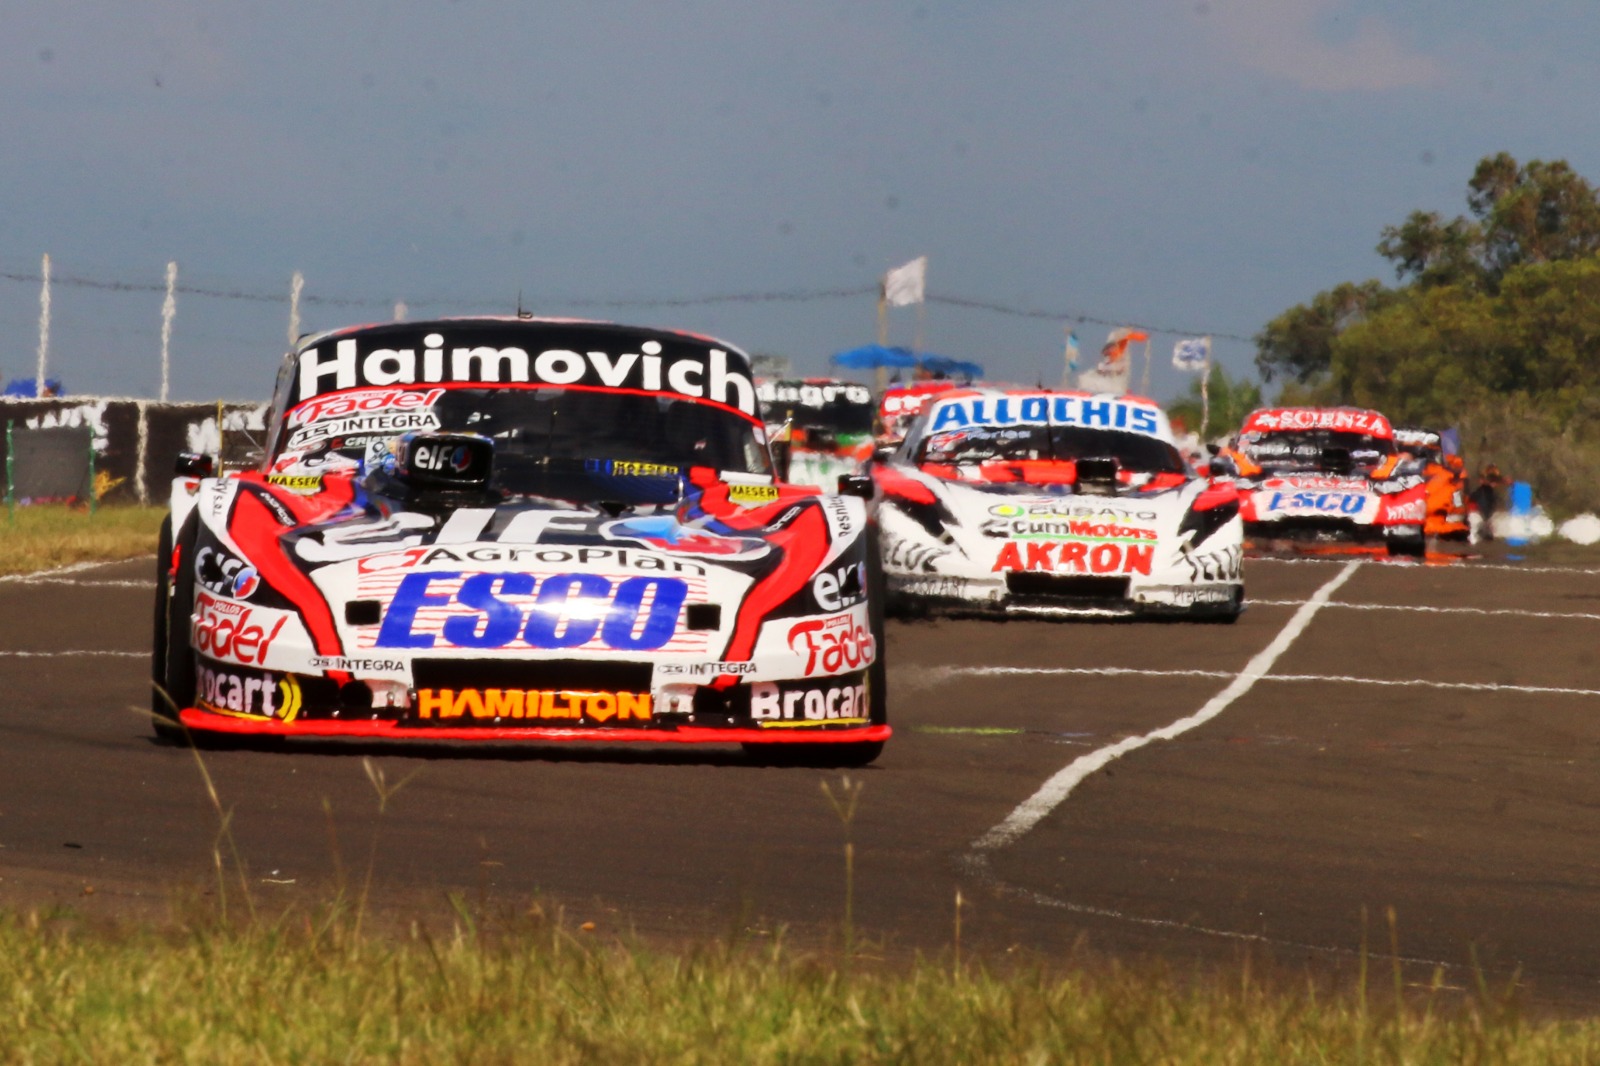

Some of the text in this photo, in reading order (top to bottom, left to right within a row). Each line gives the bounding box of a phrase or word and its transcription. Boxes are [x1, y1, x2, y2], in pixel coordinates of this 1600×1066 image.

[299, 333, 756, 417] Haimovich
[297, 389, 441, 423] Fadel
[931, 397, 1157, 434] ALLOCHIS
[342, 414, 437, 433] INTEGRA
[1279, 411, 1387, 434] SCIENZA
[414, 445, 453, 471] elf
[730, 485, 777, 497] KAESER
[990, 541, 1156, 576] AKRON
[373, 570, 690, 650] ESCO
[336, 658, 405, 671] INTEGRA
[689, 662, 758, 674] INTEGRA
[418, 688, 651, 722] HAMILTON
